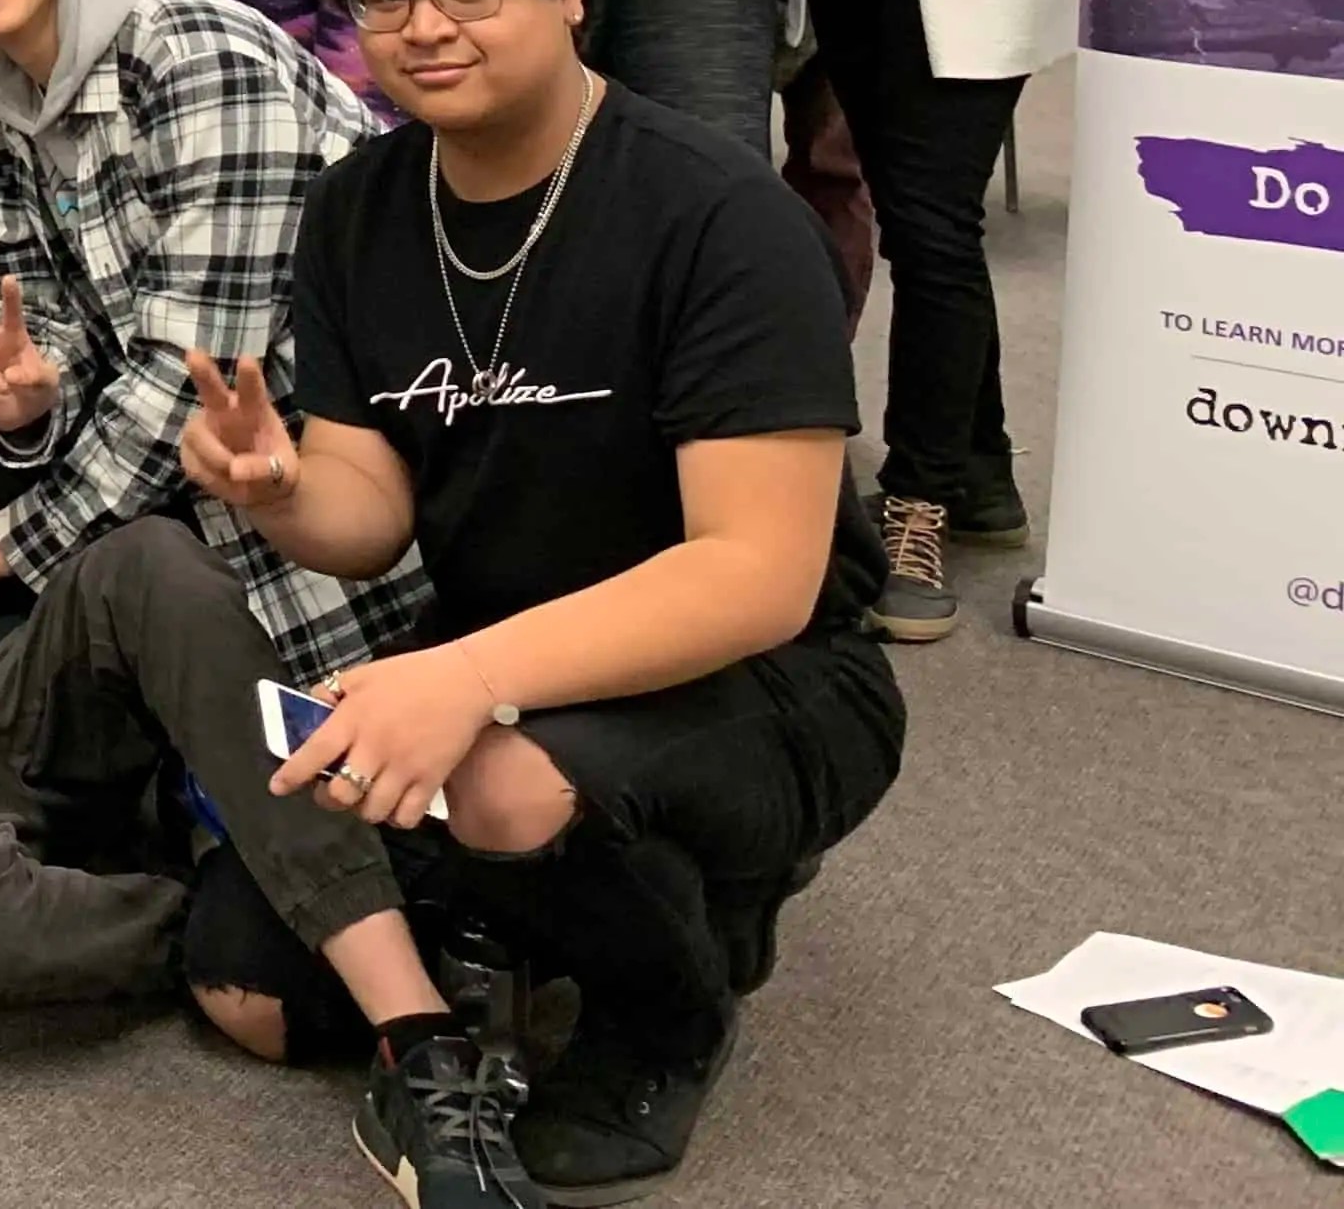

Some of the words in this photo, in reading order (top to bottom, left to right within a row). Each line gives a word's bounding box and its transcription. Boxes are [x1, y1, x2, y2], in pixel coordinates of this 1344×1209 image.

[1249, 166, 1330, 215] Do
[1160, 310, 1193, 332] TO
[1201, 317, 1282, 347] LEARN
[1291, 332, 1344, 357] MO
[1186, 387, 1344, 452] down
[1287, 577, 1344, 611] @d
